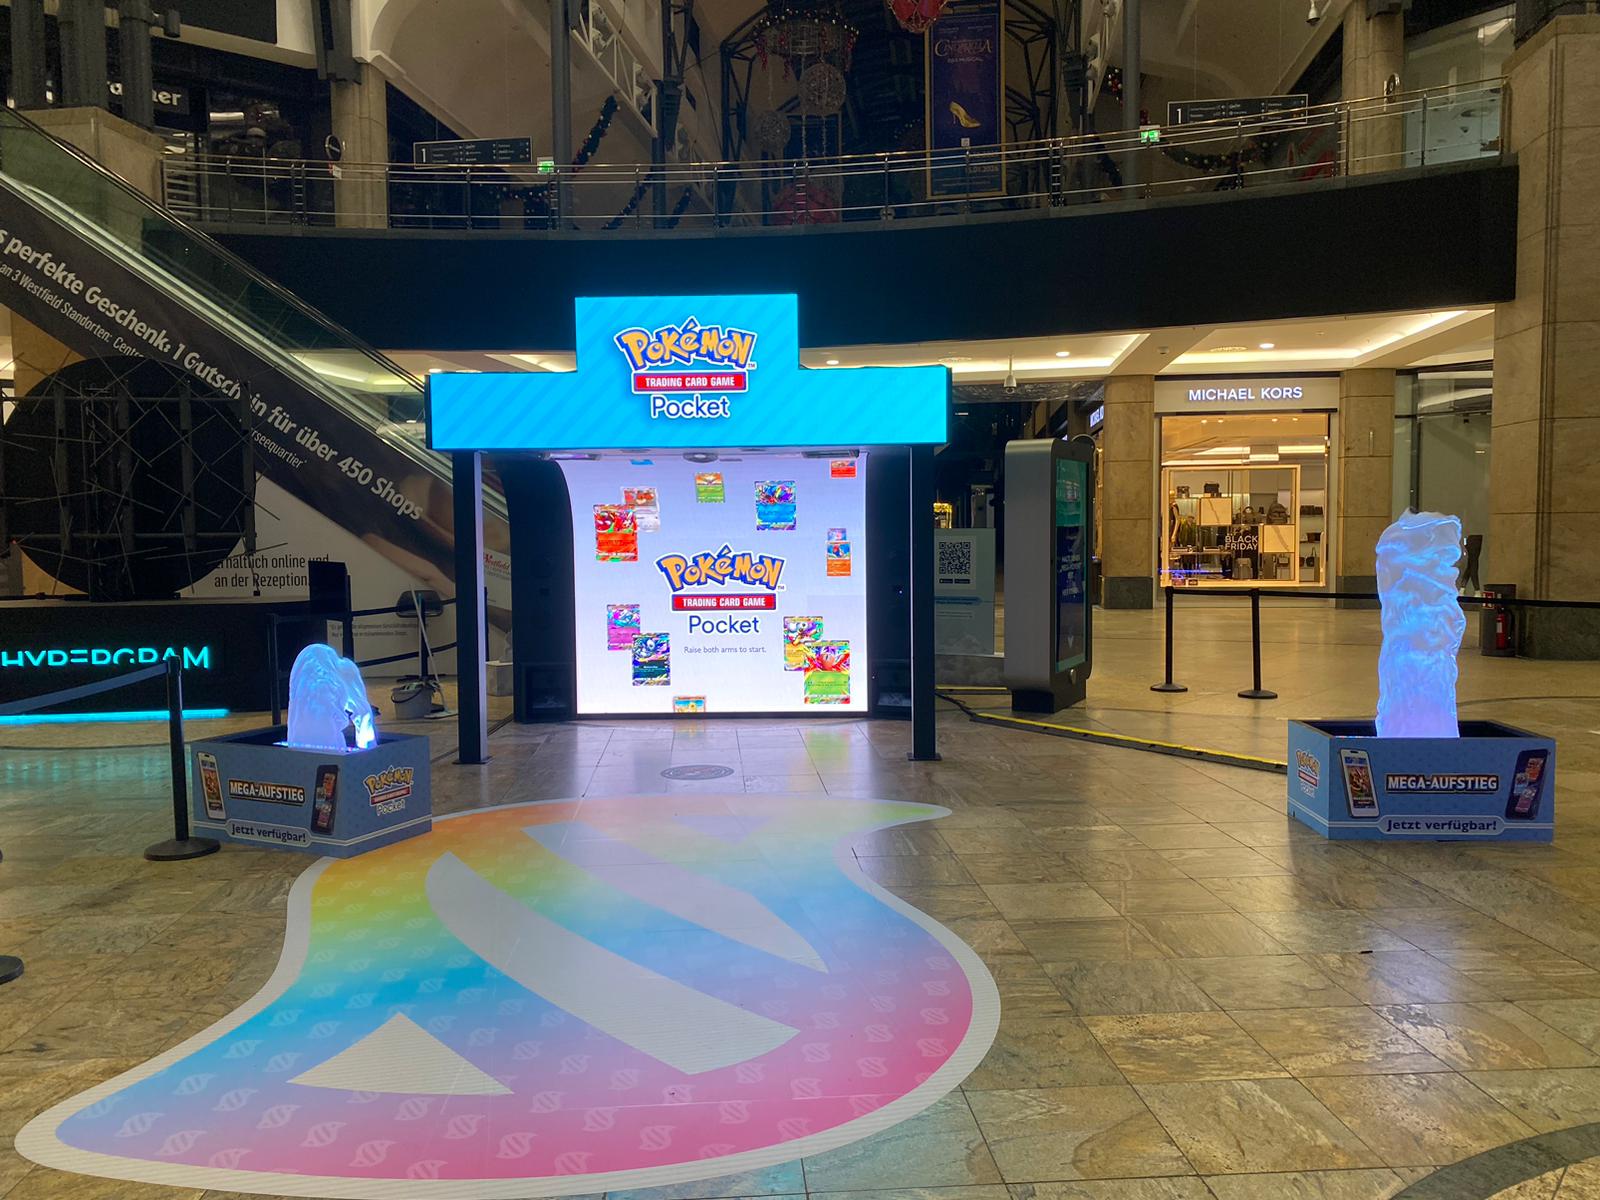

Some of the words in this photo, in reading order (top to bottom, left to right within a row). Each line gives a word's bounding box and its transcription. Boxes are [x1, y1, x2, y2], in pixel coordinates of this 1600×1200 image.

[12, 269, 21, 281] 3
[19, 274, 63, 309] Westfield
[61, 302, 113, 342] Standorten:
[3, 237, 84, 295] perfekte
[85, 286, 172, 353] Geschenk:
[183, 352, 267, 417] Gutschin
[267, 406, 297, 434] für
[295, 426, 338, 462] über
[337, 457, 373, 485] 450
[371, 477, 423, 520] Shops
[645, 377, 682, 388] TRADING
[685, 377, 708, 387] CARD
[710, 377, 735, 387] GAME
[1189, 388, 1255, 401] MICHAEL
[1260, 387, 1303, 399] KORS
[652, 395, 729, 417] Pocket
[1225, 535, 1258, 543] BLACK
[1225, 542, 1258, 550] FRIDAY
[271, 553, 306, 569] online
[214, 576, 228, 587] an
[231, 573, 249, 587] der
[683, 597, 717, 607] TRADING
[719, 597, 740, 607] CARD
[742, 597, 766, 607] GAME
[689, 615, 760, 634] Pocket
[684, 646, 701, 654] Raise
[1387, 775, 1498, 790] MEGA-AUFSTIEG
[230, 781, 304, 802] MEGA-AUFSTIEG
[1387, 819, 1420, 832] Jetzt
[1425, 820, 1497, 833] verfügbar!
[231, 824, 255, 835] Jetzt
[256, 829, 306, 843] verfügbar!
